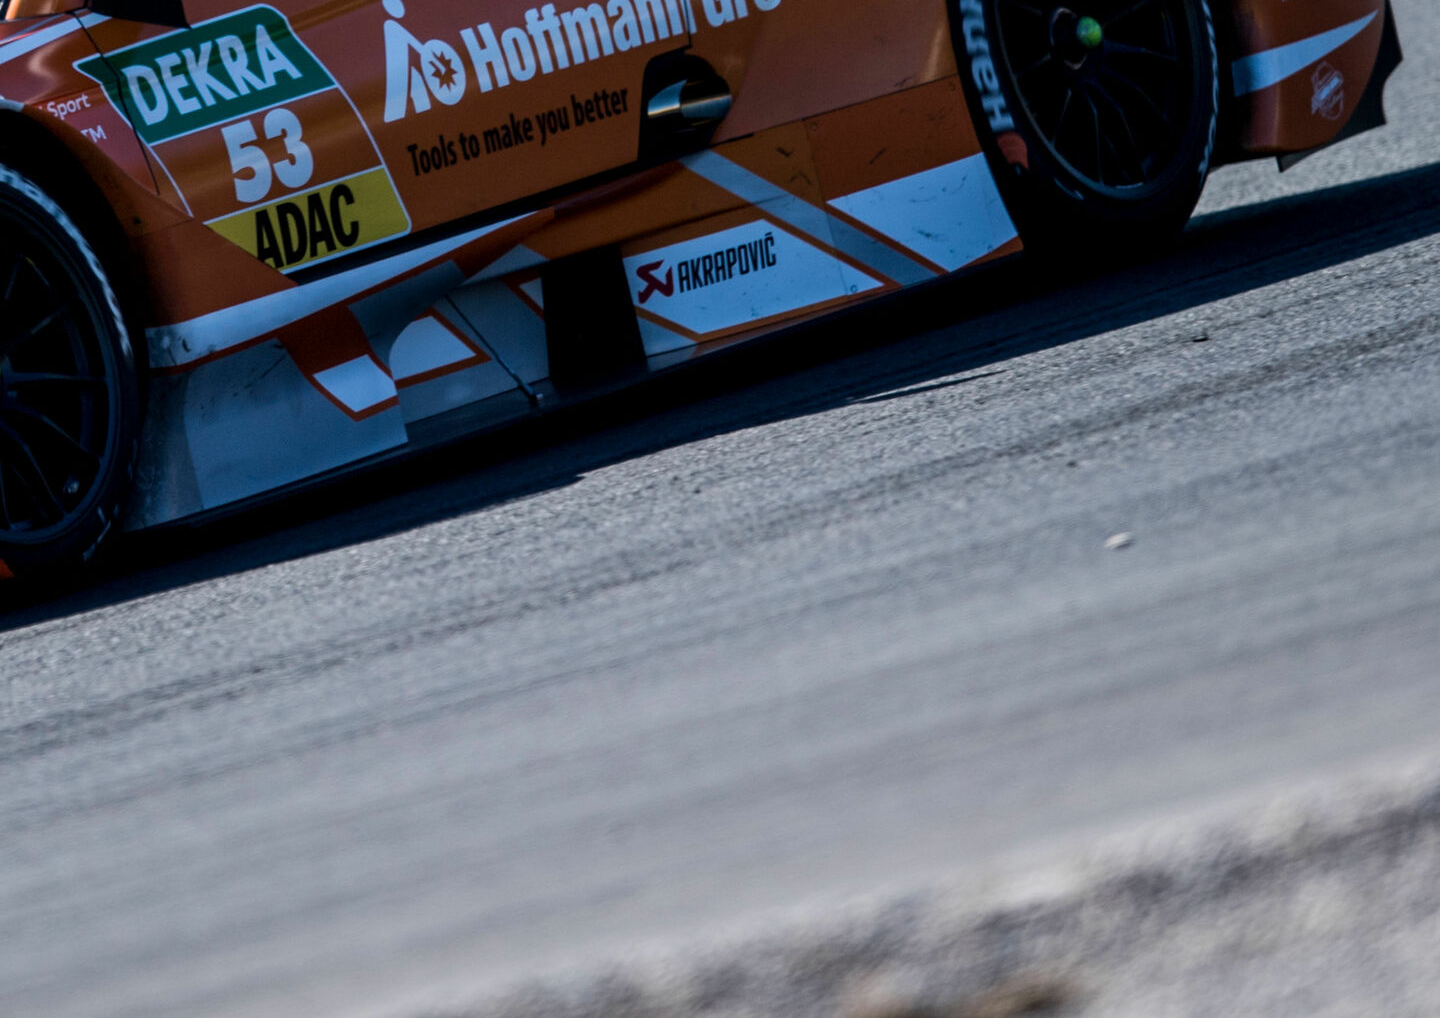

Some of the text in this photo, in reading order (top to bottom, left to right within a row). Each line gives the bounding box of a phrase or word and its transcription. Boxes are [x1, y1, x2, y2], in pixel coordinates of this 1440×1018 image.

[46, 93, 91, 120] Sport
[121, 24, 304, 126] DEKRA
[221, 108, 314, 203] 53
[407, 88, 630, 177] Tools to make you better
[255, 184, 360, 270] ADAC
